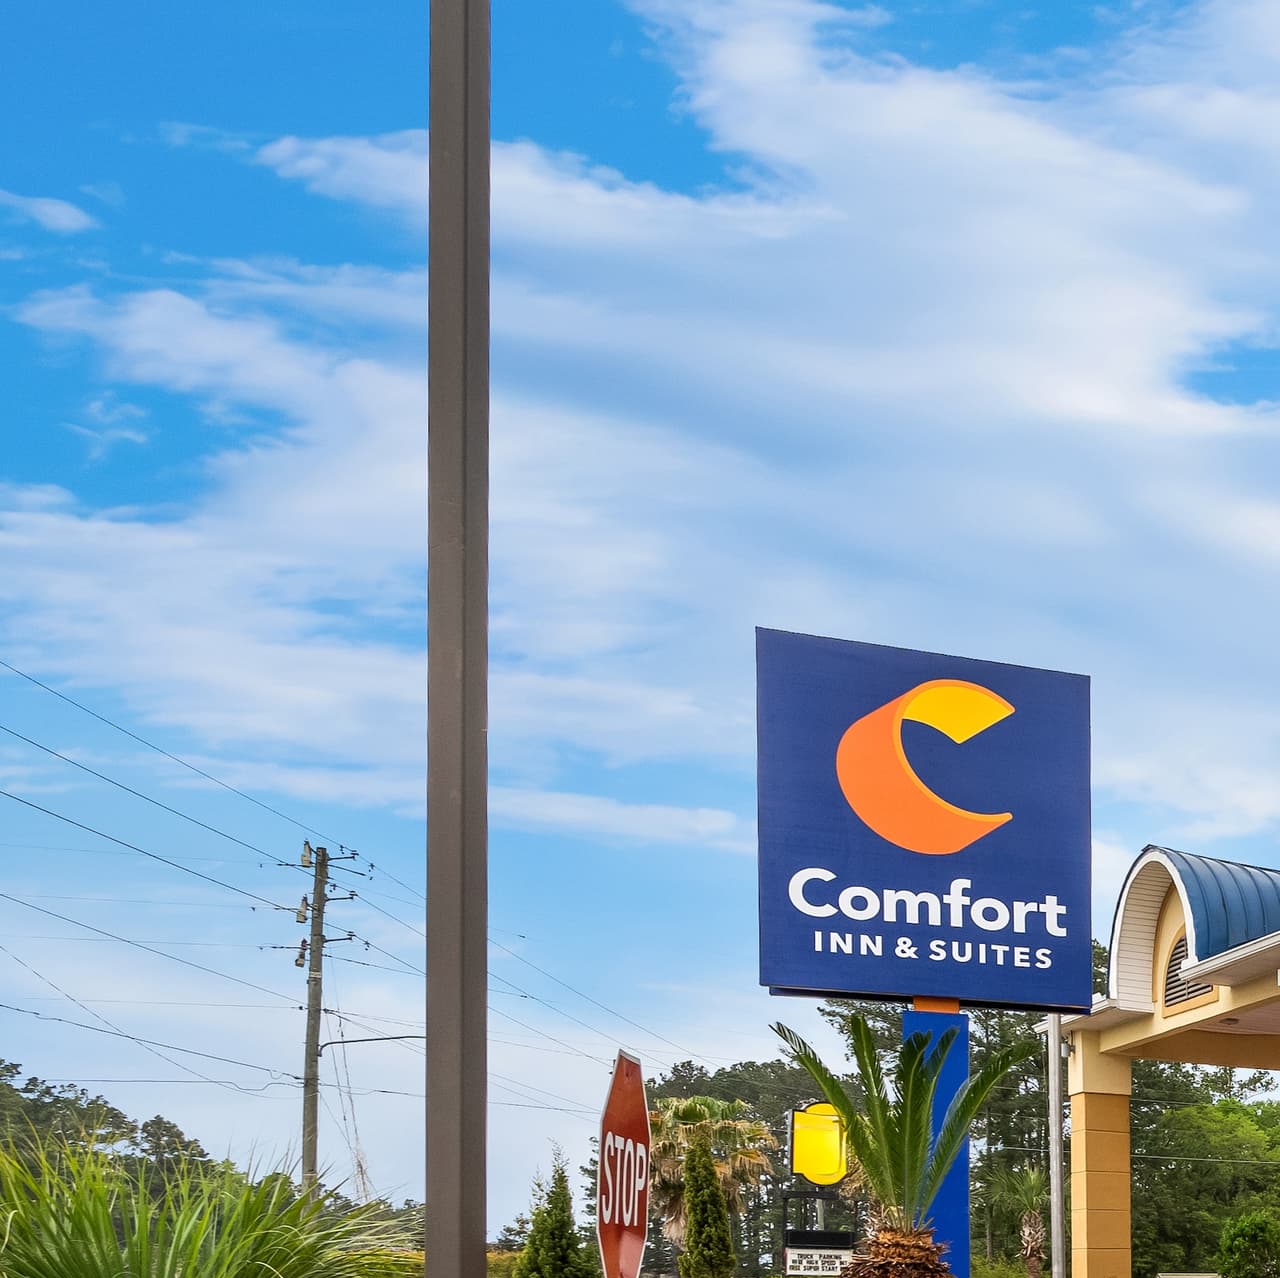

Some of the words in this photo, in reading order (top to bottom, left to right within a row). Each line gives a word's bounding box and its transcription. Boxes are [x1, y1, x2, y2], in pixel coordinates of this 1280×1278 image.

[788, 867, 1067, 937] Comfort
[814, 930, 883, 957] INN
[894, 936, 919, 960] &
[929, 939, 1053, 969] SUITES
[602, 1131, 646, 1227] STOP
